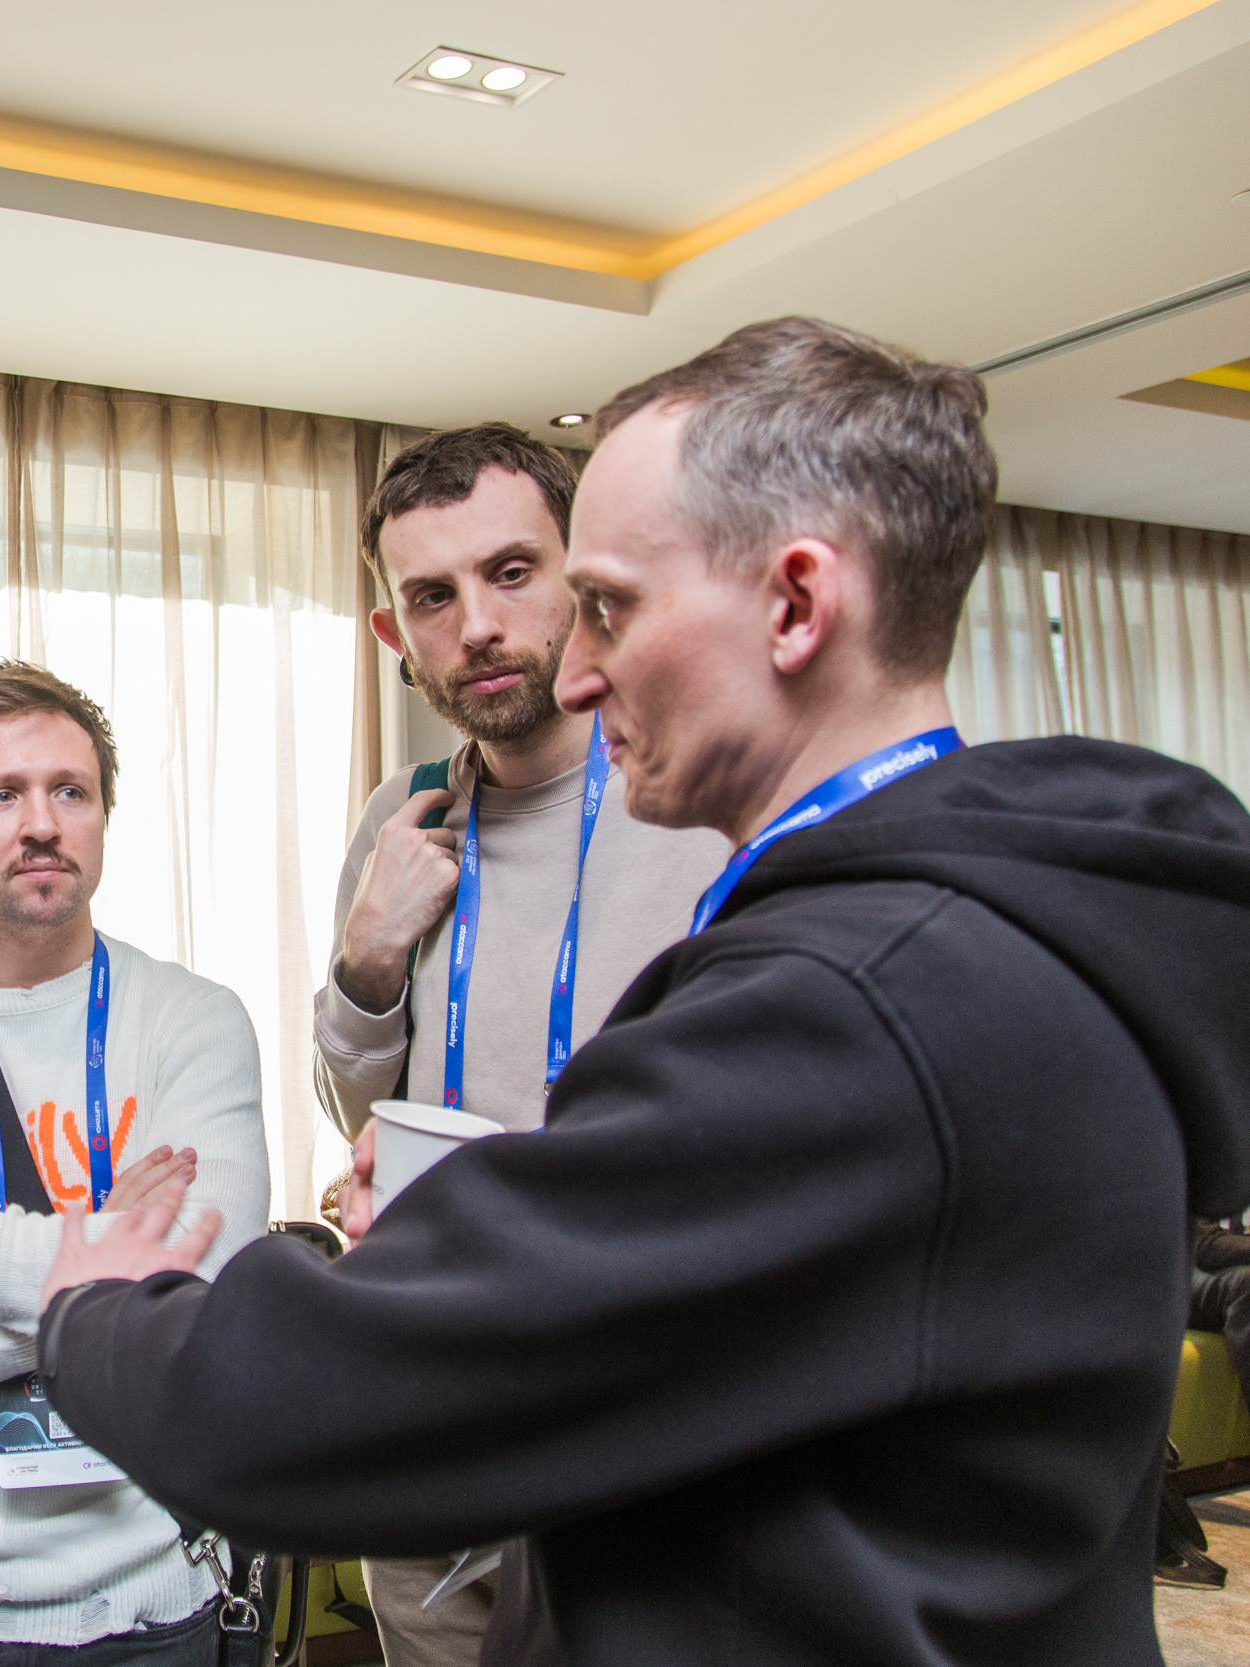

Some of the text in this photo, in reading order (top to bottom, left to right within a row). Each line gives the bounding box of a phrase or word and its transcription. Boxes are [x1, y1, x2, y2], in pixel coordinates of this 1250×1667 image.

[858, 741, 938, 791] precisely
[456, 924, 467, 965] ataccama
[561, 940, 571, 984] ataccama
[448, 1002, 459, 1048] precisely
